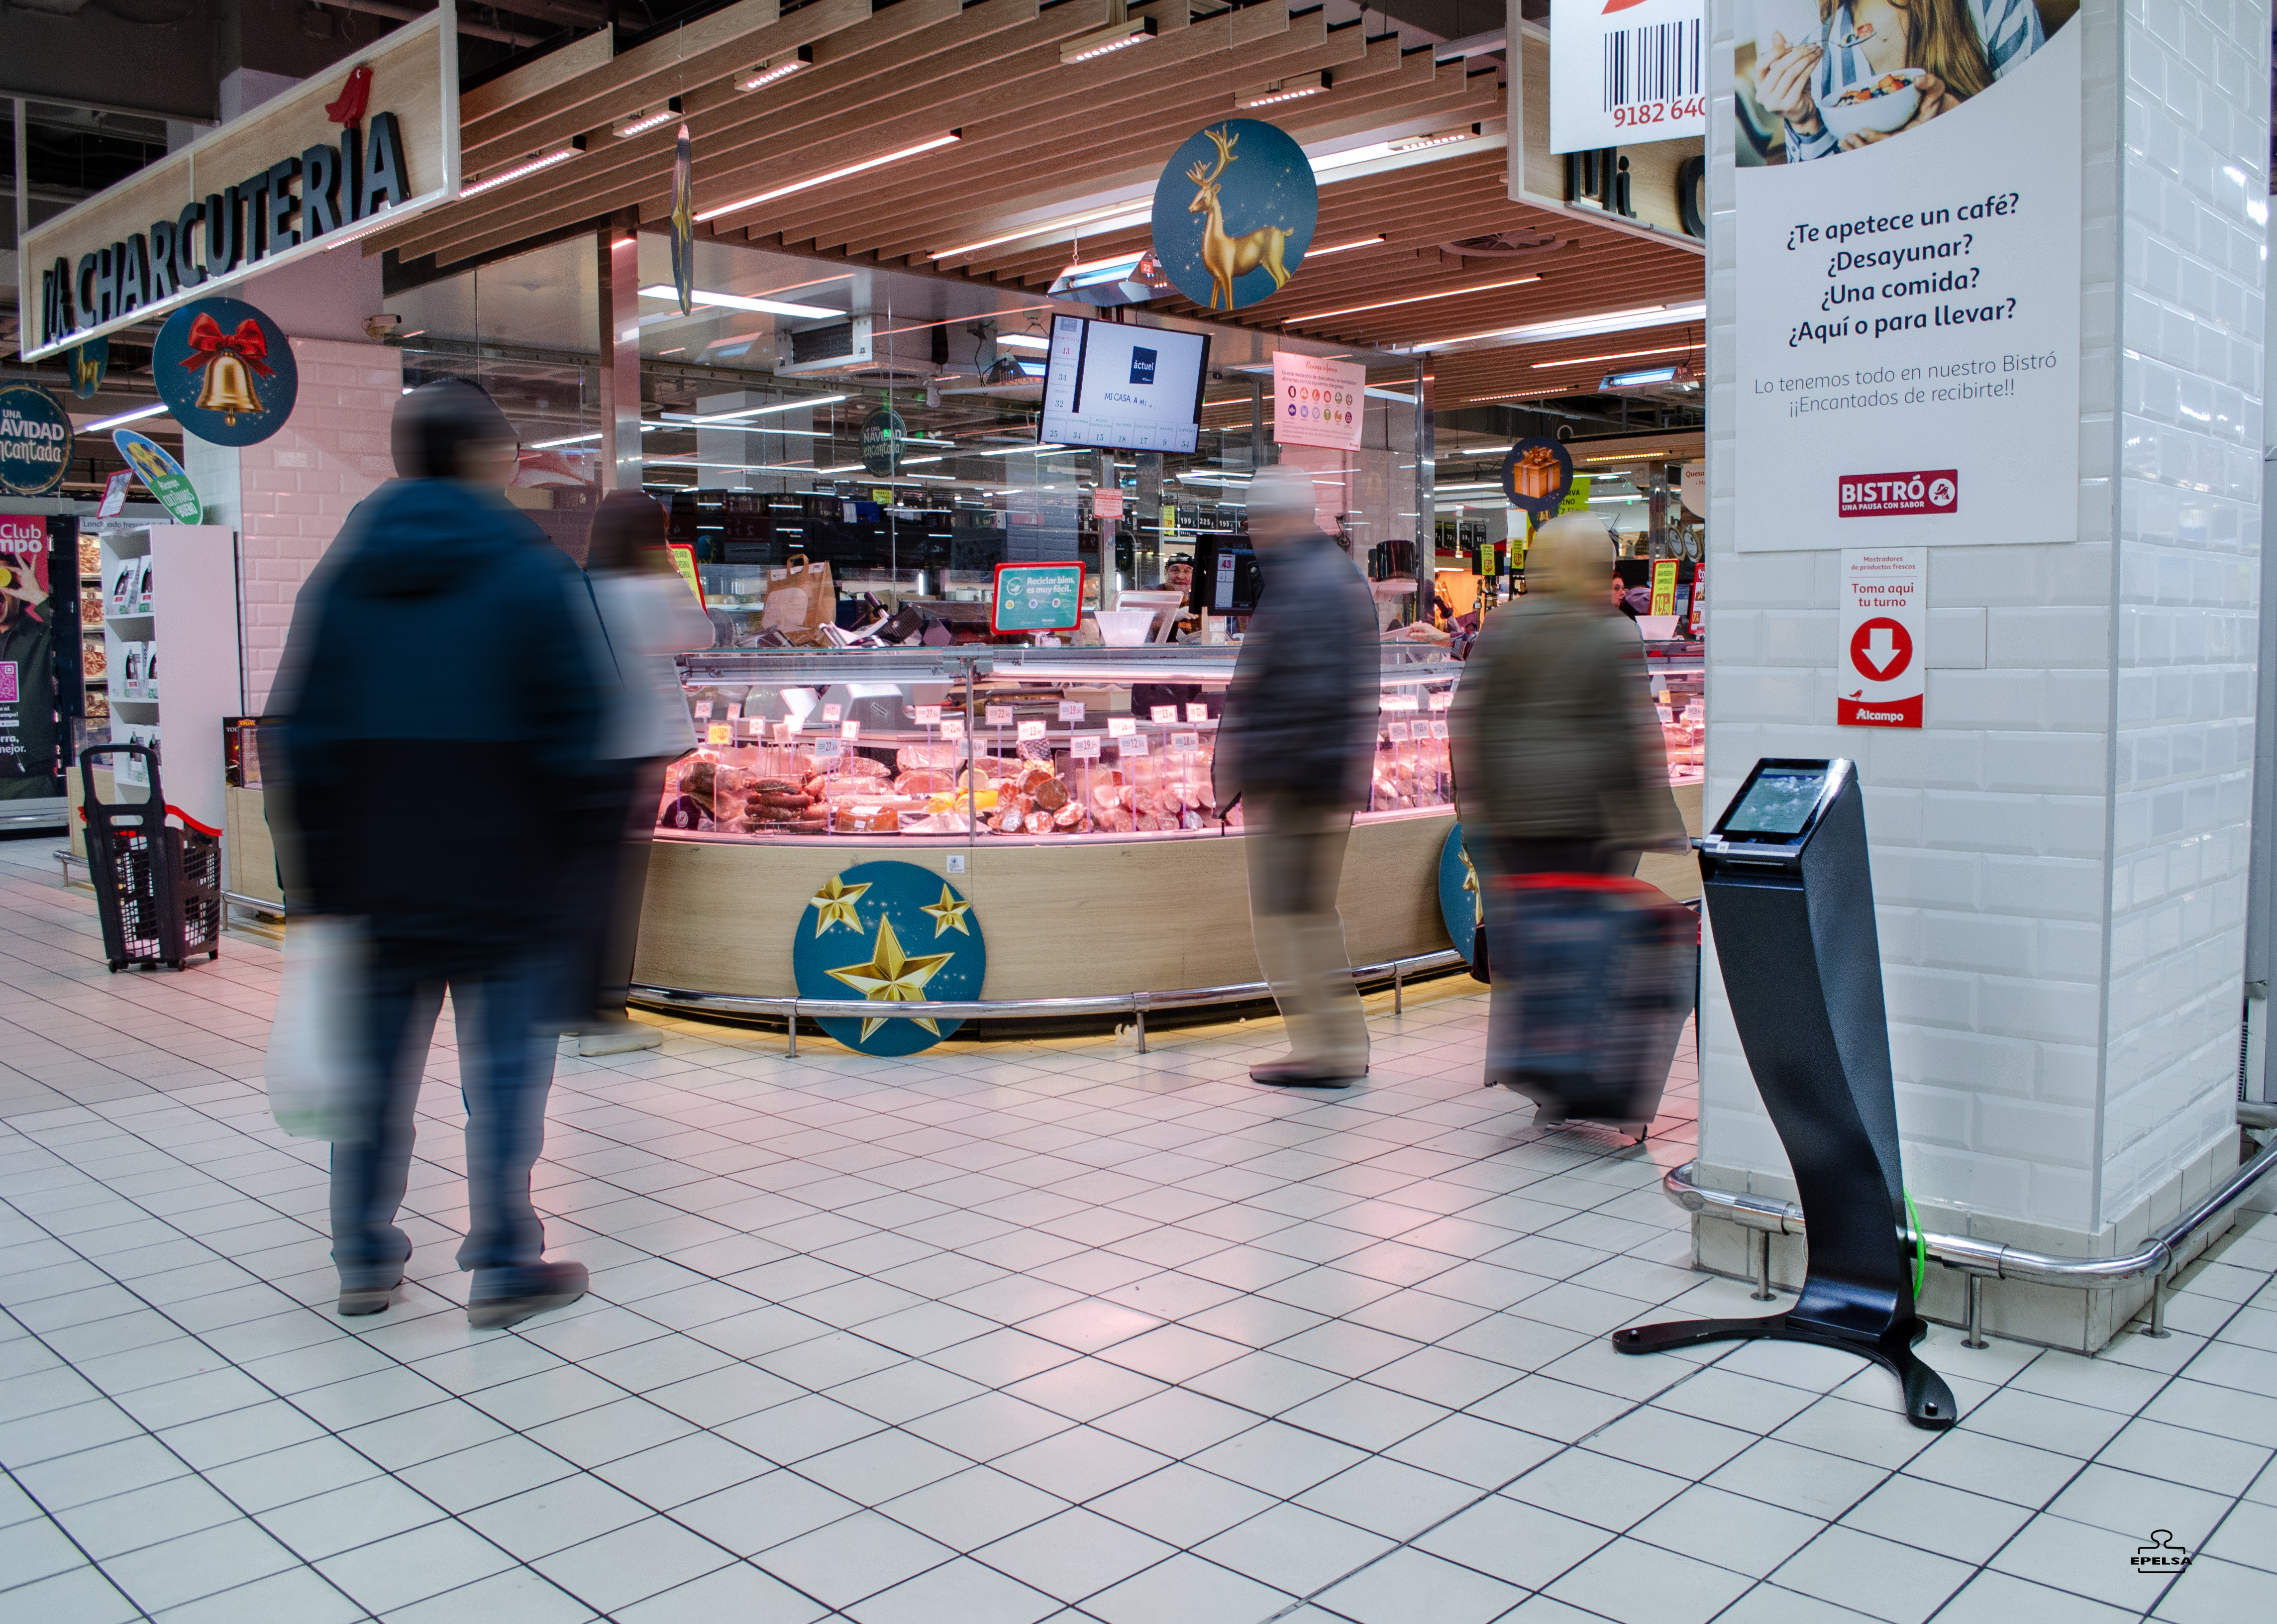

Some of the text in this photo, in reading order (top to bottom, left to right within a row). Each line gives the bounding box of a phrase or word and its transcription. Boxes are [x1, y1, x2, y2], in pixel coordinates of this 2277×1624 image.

[1614, 102, 1664, 128] 9182
[1787, 193, 2019, 250] ¿Te apetece un café?
[1828, 234, 1973, 278] ¿Desayunar?
[1143, 264, 1151, 272] 22
[1821, 267, 1980, 311] ¿Una comida?
[1789, 298, 2016, 347] ¿Aquí o para llevar?
[1306, 361, 1322, 372] Alcampo
[1755, 351, 2057, 394] Lo tenemos todo en nuestro Bistró
[1789, 379, 2014, 417] ¡¡Encantados de recibirte!!
[2, 409, 22, 419] UNA
[1842, 475, 1925, 503] BISTRÓ
[0, 523, 42, 539] Club
[1222, 560, 1231, 569] 43
[1027, 576, 1075, 585] Reciclar bien,
[1852, 582, 1914, 596] Toma aqui
[1859, 598, 1906, 607] tu turno
[1856, 708, 1904, 721] Alcampo
